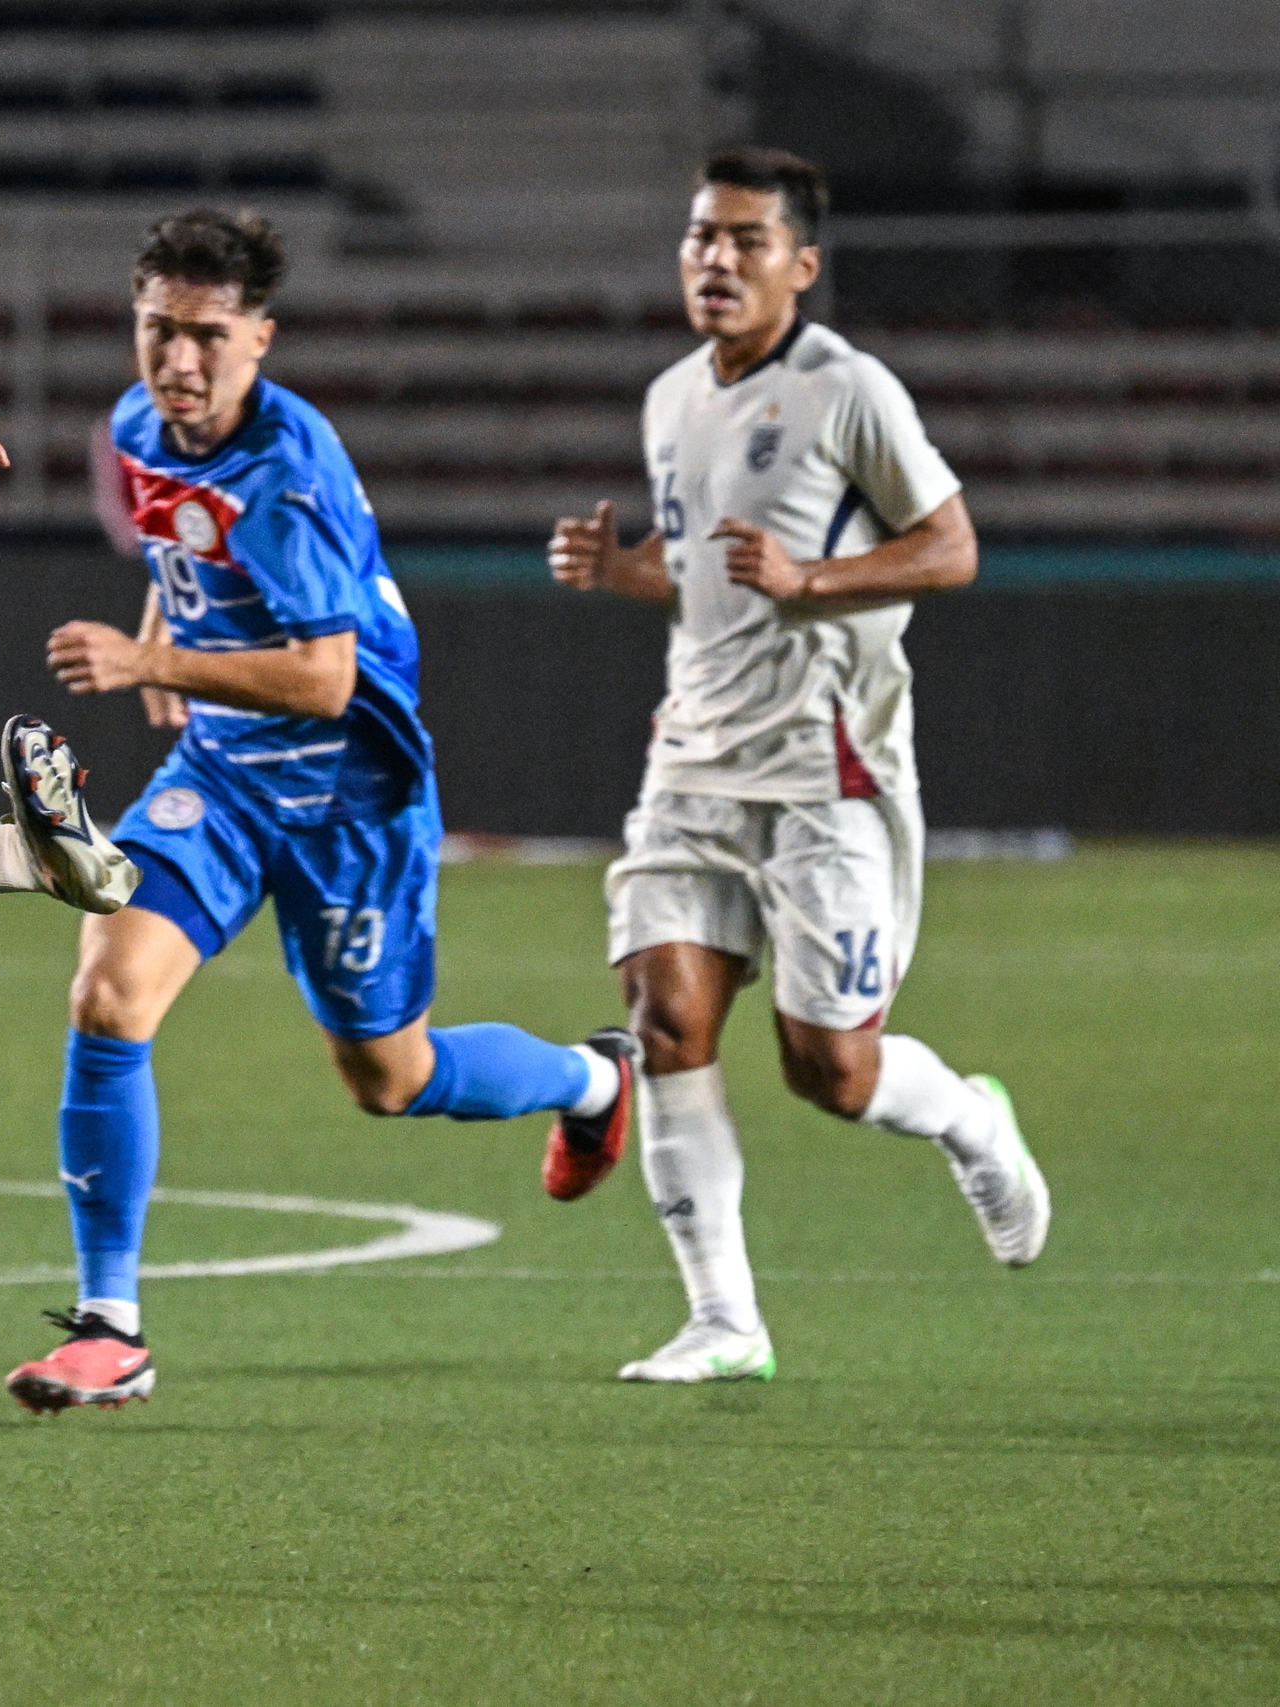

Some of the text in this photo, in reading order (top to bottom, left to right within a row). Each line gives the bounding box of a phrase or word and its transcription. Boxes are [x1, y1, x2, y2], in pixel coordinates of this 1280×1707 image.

[146, 543, 207, 620] 19
[320, 906, 385, 973] 19
[835, 929, 881, 997] 16
